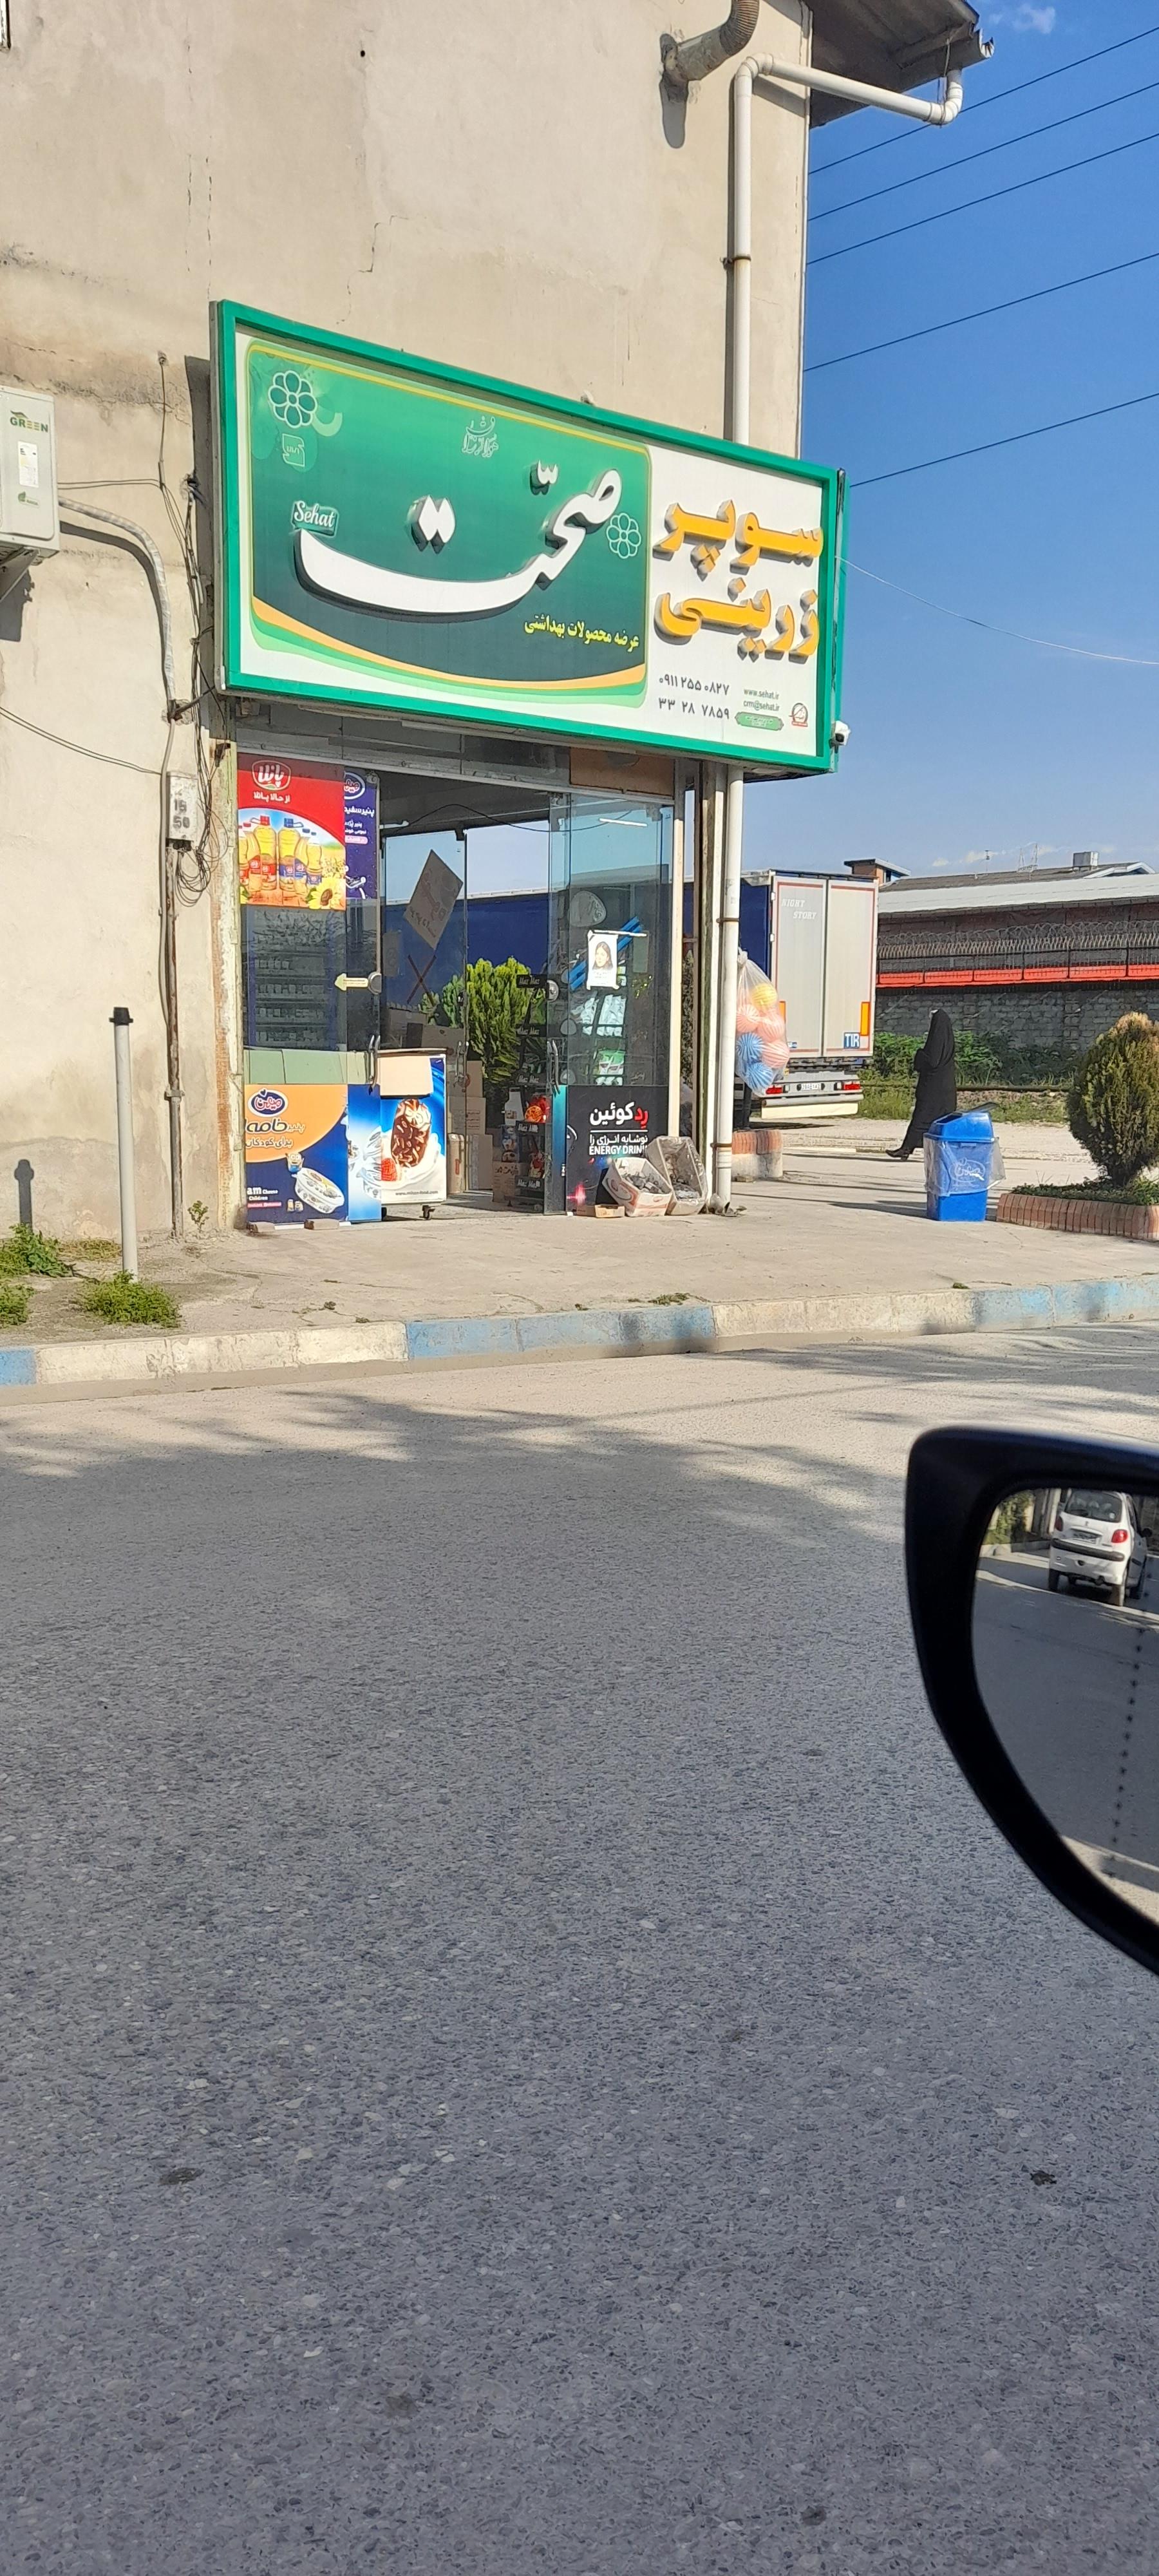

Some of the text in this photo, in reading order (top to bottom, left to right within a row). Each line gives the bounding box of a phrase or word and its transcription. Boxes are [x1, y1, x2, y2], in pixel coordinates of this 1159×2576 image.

[10, 417, 49, 433] GREEN
[294, 500, 335, 527] Sehat
[652, 499, 824, 582] سوپر
[654, 577, 820, 664] زرینی
[524, 614, 639, 652] عرضه محصولات بهداشتی
[681, 677, 701, 691] ۲۵۵
[704, 682, 730, 695] ۰۸۲۷
[744, 688, 779, 700] www.sehat.ir
[659, 697, 730, 719] ۳۳ ۲۸ ۷۸۵۹
[743, 700, 780, 712] crm@sehat.ir
[270, 793, 284, 801] حالا
[793, 911, 816, 919] STORY
[845, 1033, 860, 1047] TIR
[590, 1102, 634, 1126] کوئین
[275, 1137, 293, 1148] برای
[590, 1133, 648, 1146] نوشابه انرژی زا
[589, 1146, 621, 1155] ENERGY
